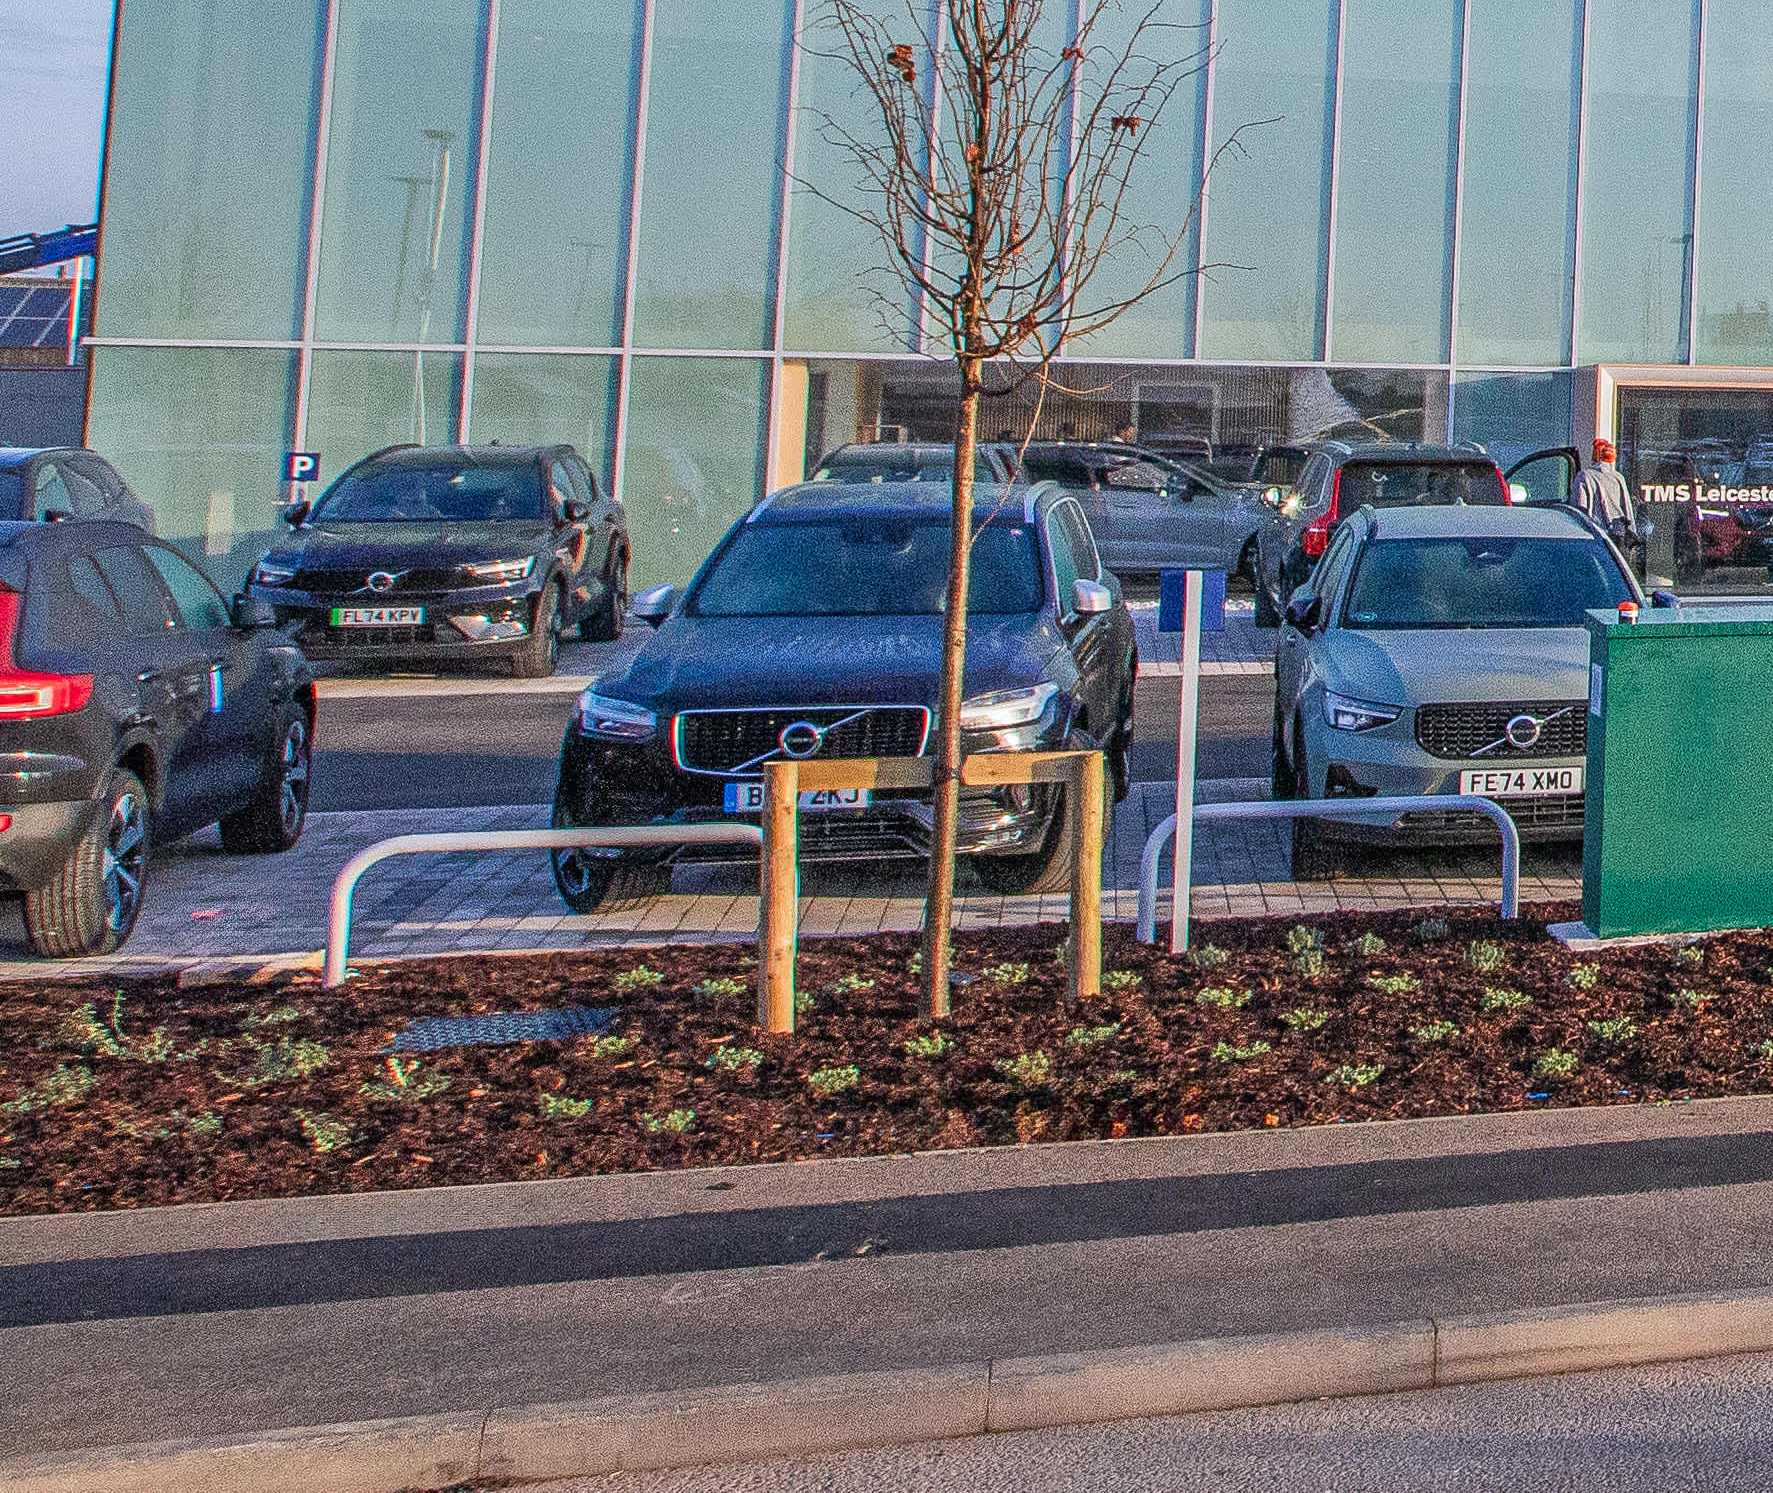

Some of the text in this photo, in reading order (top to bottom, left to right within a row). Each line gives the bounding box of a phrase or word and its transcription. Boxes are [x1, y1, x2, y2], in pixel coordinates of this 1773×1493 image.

[291, 455, 315, 478] P
[1641, 484, 1690, 502] TMS
[1470, 772, 1526, 793] FE74
